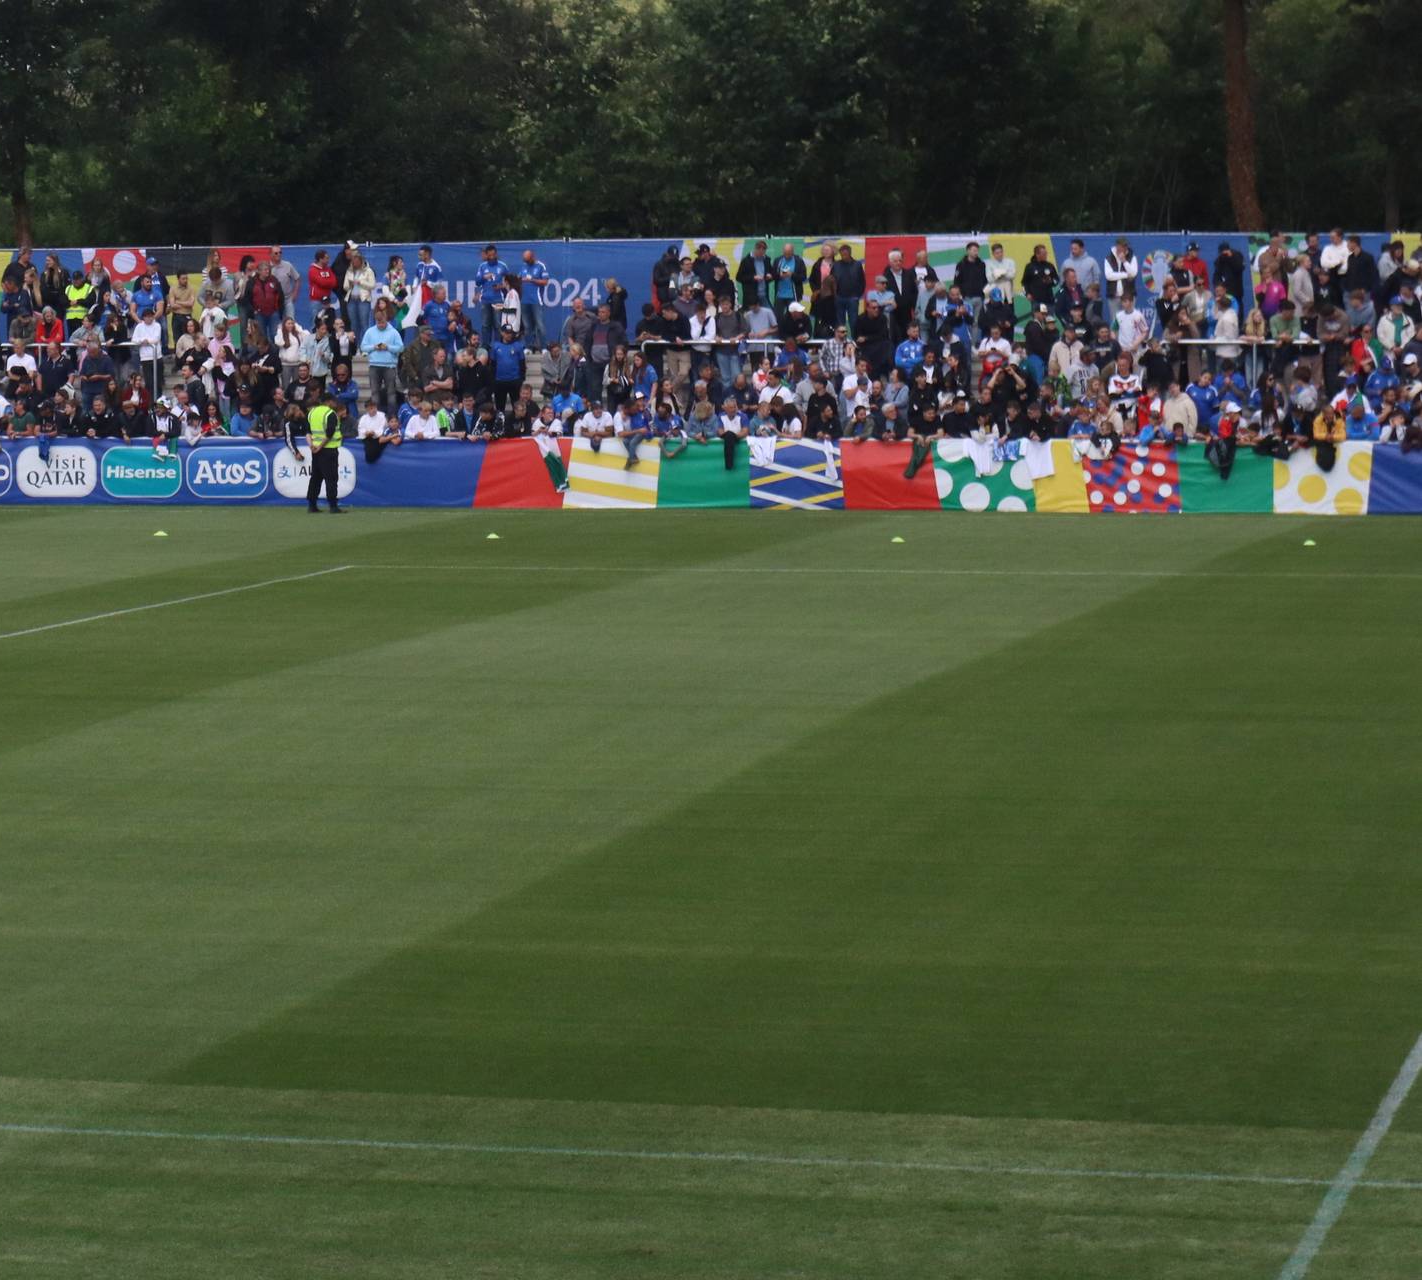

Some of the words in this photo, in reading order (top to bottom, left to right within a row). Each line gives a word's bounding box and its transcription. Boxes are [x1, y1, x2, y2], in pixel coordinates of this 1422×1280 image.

[543, 278, 601, 307] 024
[27, 471, 86, 488] QATAR
[106, 465, 176, 479] Hisense
